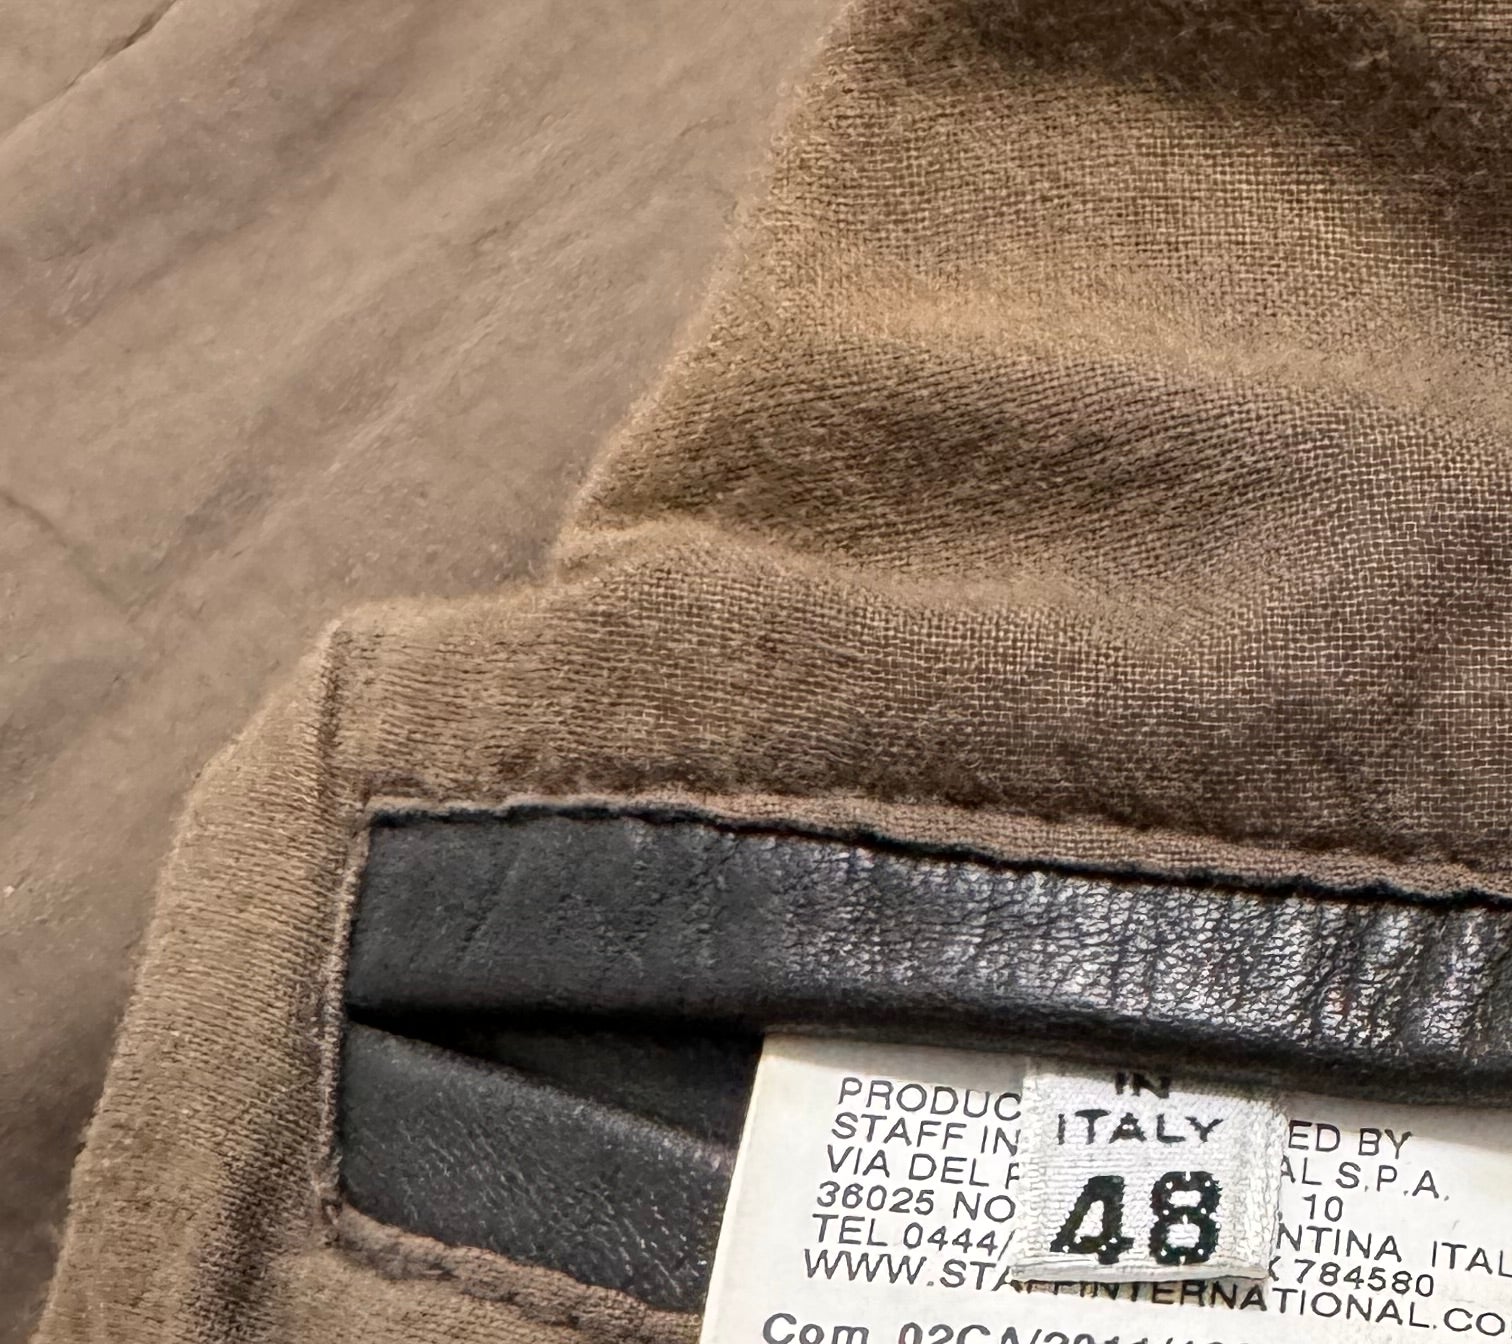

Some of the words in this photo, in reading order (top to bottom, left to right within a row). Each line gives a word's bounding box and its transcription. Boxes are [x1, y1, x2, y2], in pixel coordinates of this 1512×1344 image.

[838, 1077, 1021, 1121] PRODUC
[1358, 1127, 1412, 1159] BY
[1114, 1072, 1172, 1098] IN
[832, 1112, 967, 1149] STAFF
[1336, 1161, 1450, 1201] S.P.A.
[1058, 1108, 1224, 1145] ITALY
[816, 1180, 934, 1216] 36025
[827, 1144, 890, 1178] VIA
[908, 1153, 989, 1187] DEL
[1303, 1193, 1344, 1222] 10
[1050, 1171, 1222, 1265] 48
[812, 1213, 888, 1247] TEL
[1294, 1258, 1434, 1298] 784580
